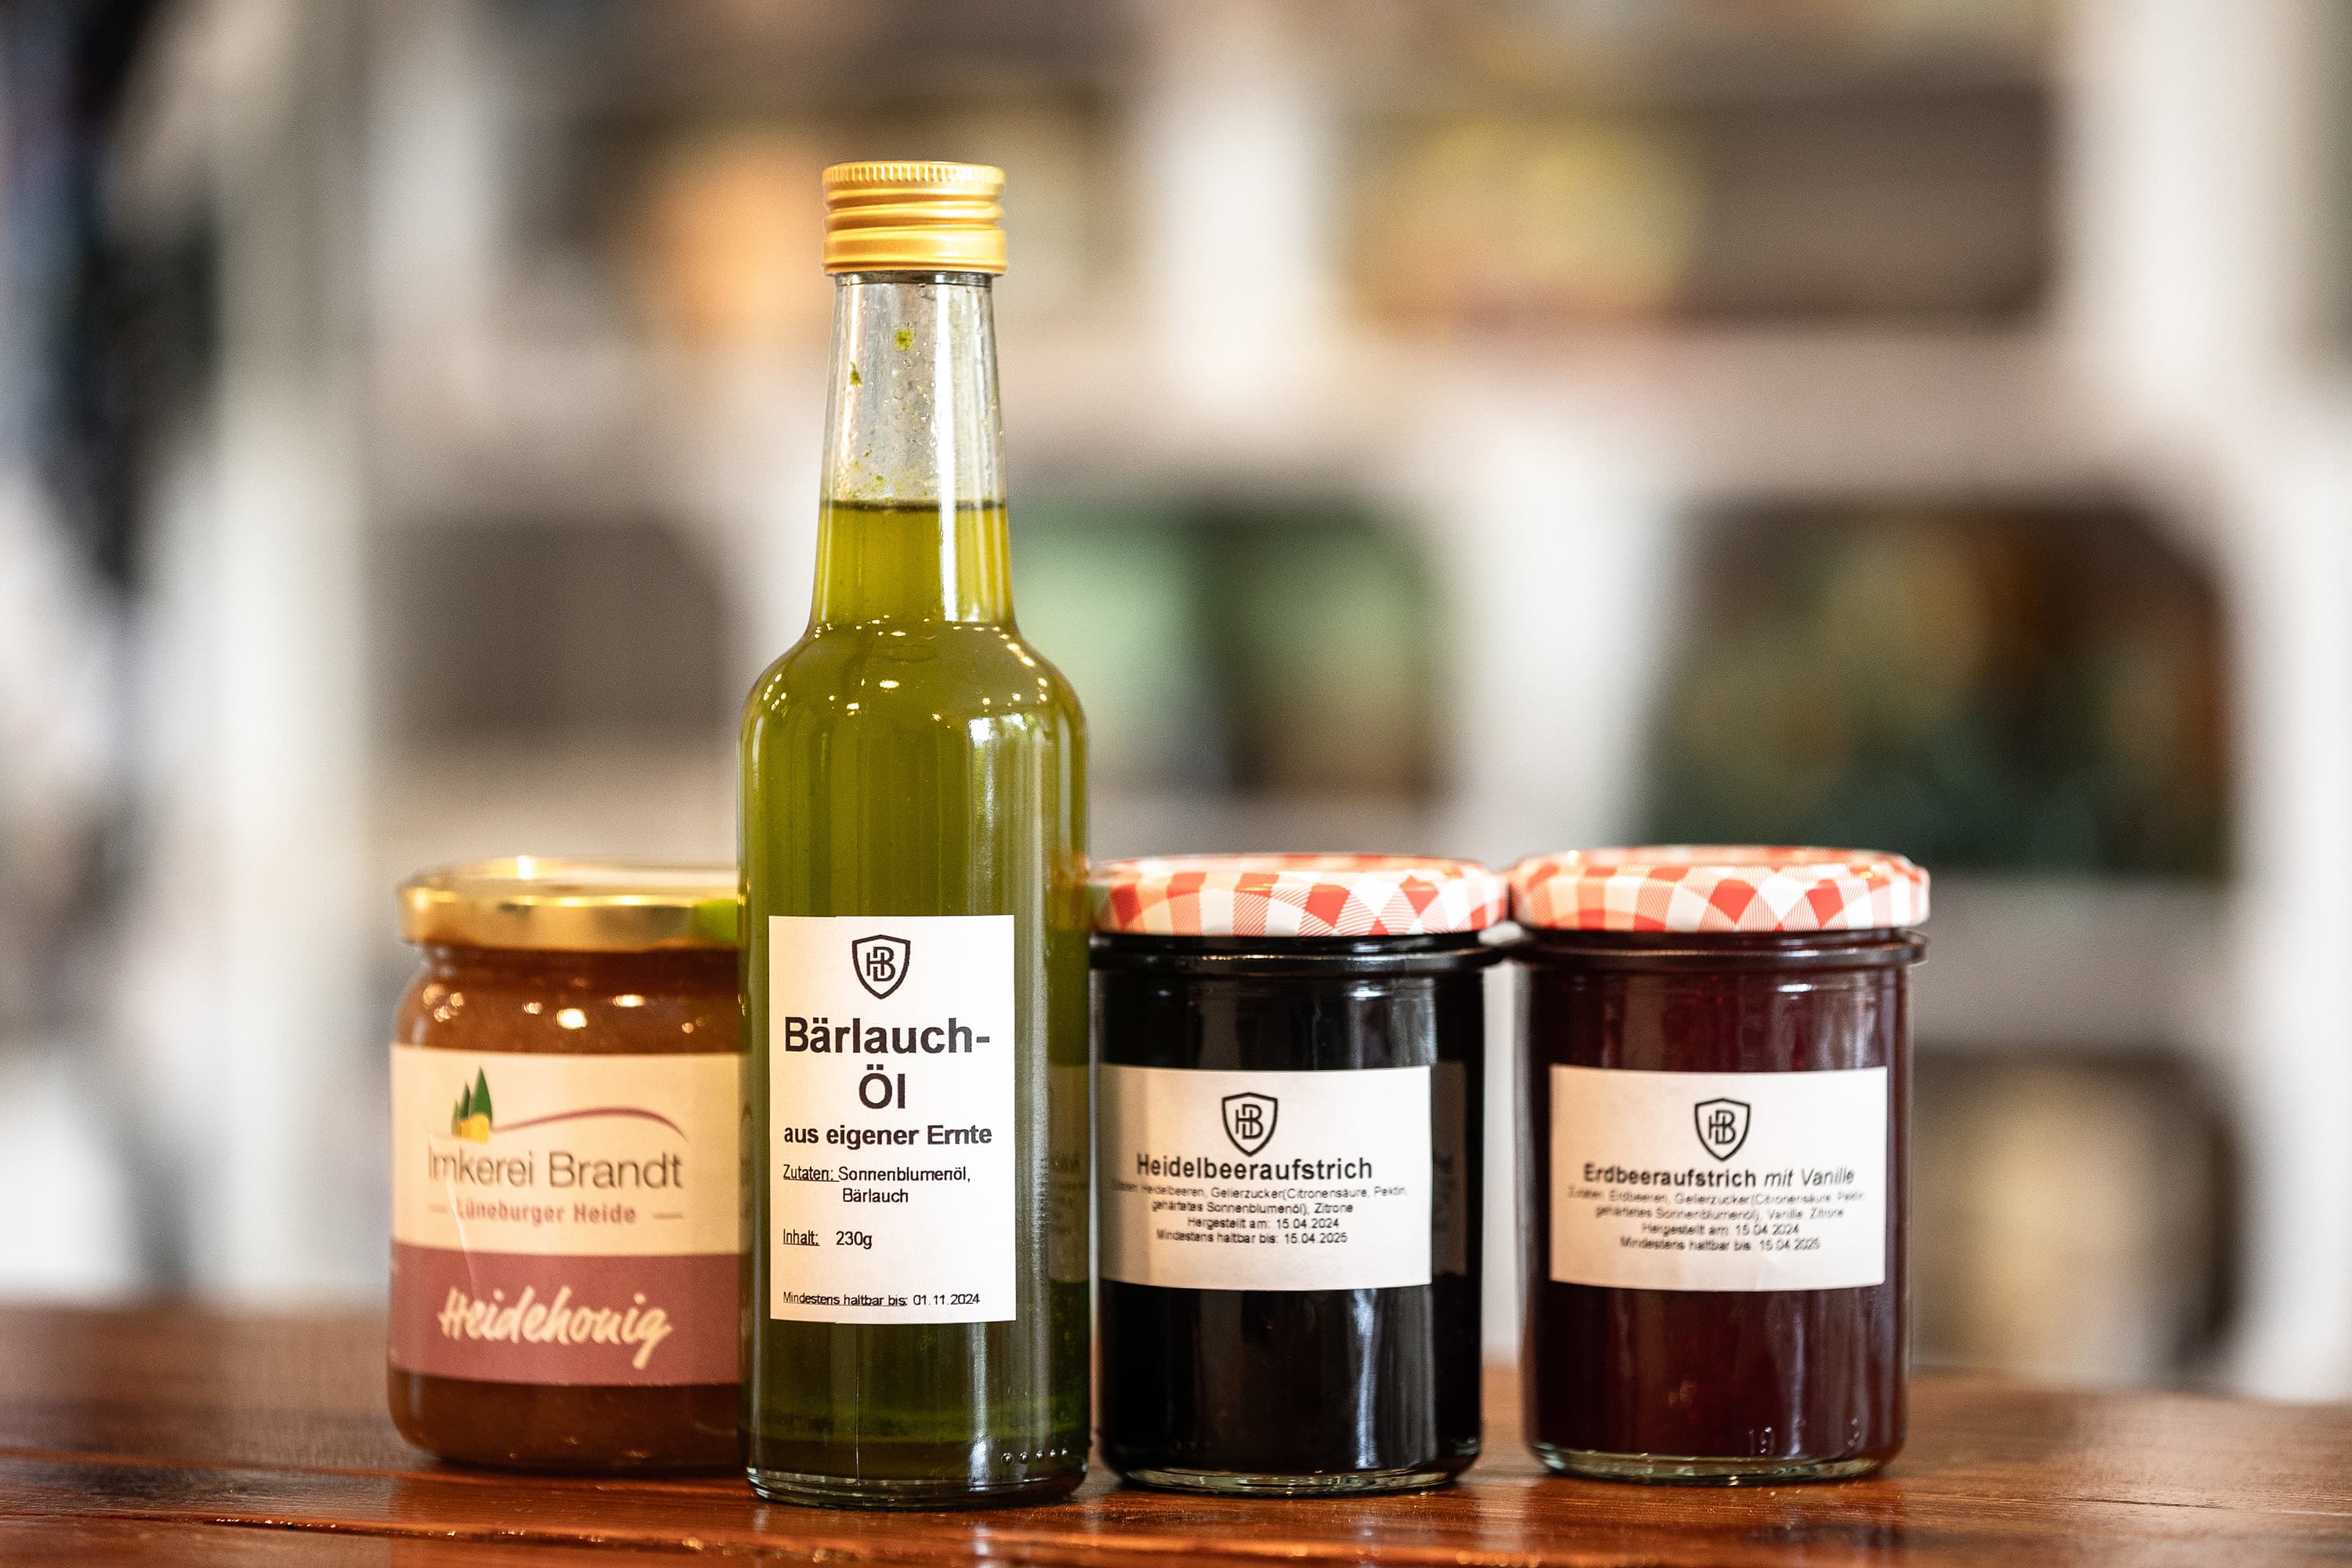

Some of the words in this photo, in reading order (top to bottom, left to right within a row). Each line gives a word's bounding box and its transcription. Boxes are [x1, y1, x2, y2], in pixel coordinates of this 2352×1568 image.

[785, 1016, 990, 1054] Bärlauch-
[858, 1064, 906, 1109] Öl
[784, 1127, 818, 1143] aus
[826, 1125, 920, 1149] eigener
[927, 1126, 993, 1145] Ernte
[428, 1144, 535, 1189] Imkerei
[548, 1151, 684, 1189] Brandt
[783, 1164, 833, 1181] Zutaten:
[838, 1167, 971, 1182] Sonnenblumenöl,
[1136, 1153, 1373, 1181] Heidelbeeraufstrich
[1584, 1163, 1757, 1187] Erdbeeraufstrich
[1762, 1168, 1794, 1187] mit
[1801, 1168, 1855, 1185] Vanille
[843, 1187, 909, 1203] Bärlauch
[457, 1201, 566, 1228] Lüneburger
[573, 1203, 639, 1225] Heide
[783, 1229, 819, 1246] Inhalt:
[836, 1231, 873, 1249] 230g
[783, 1291, 840, 1306] Mindestens
[844, 1294, 883, 1306] haltbar
[887, 1295, 908, 1307] bis:
[913, 1294, 980, 1305] 01.11.2024
[437, 1286, 674, 1370] Heidehonig
